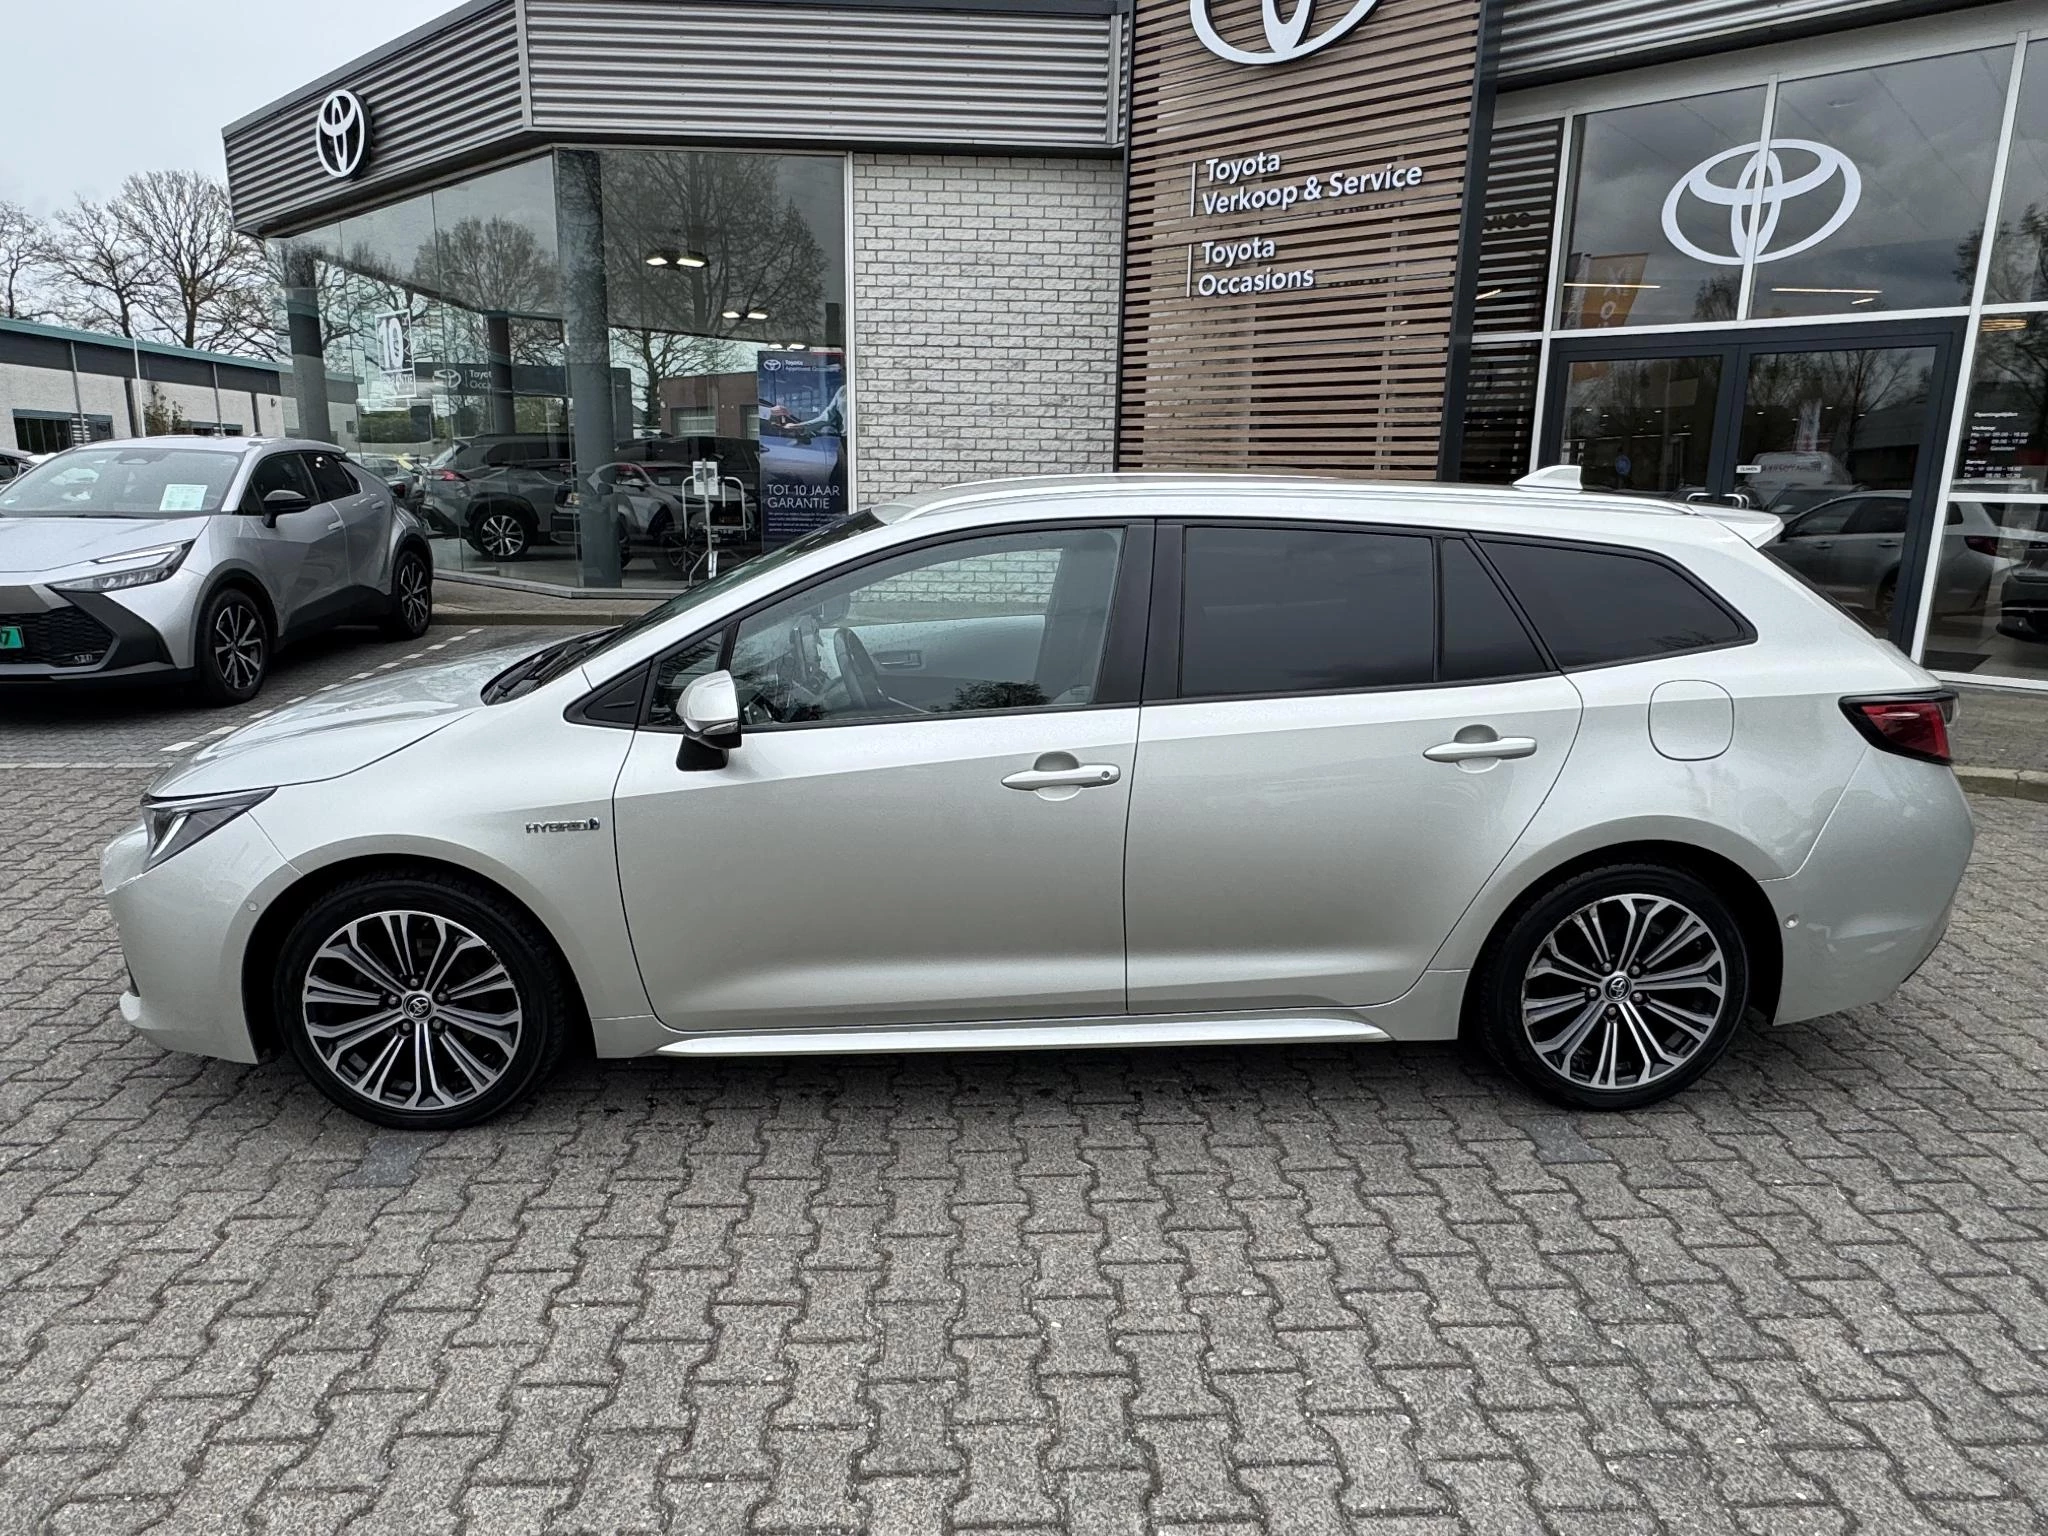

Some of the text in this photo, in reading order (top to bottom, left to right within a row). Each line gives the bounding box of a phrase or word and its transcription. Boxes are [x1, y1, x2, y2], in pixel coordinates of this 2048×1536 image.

[1205, 152, 1280, 184] Toyota
[1202, 164, 1423, 215] Verkoop & Service
[1201, 237, 1276, 268] Toyota
[1198, 267, 1315, 297] Occasions
[767, 484, 840, 496] TOT 10 JAAR
[767, 497, 830, 509] GARANTIE
